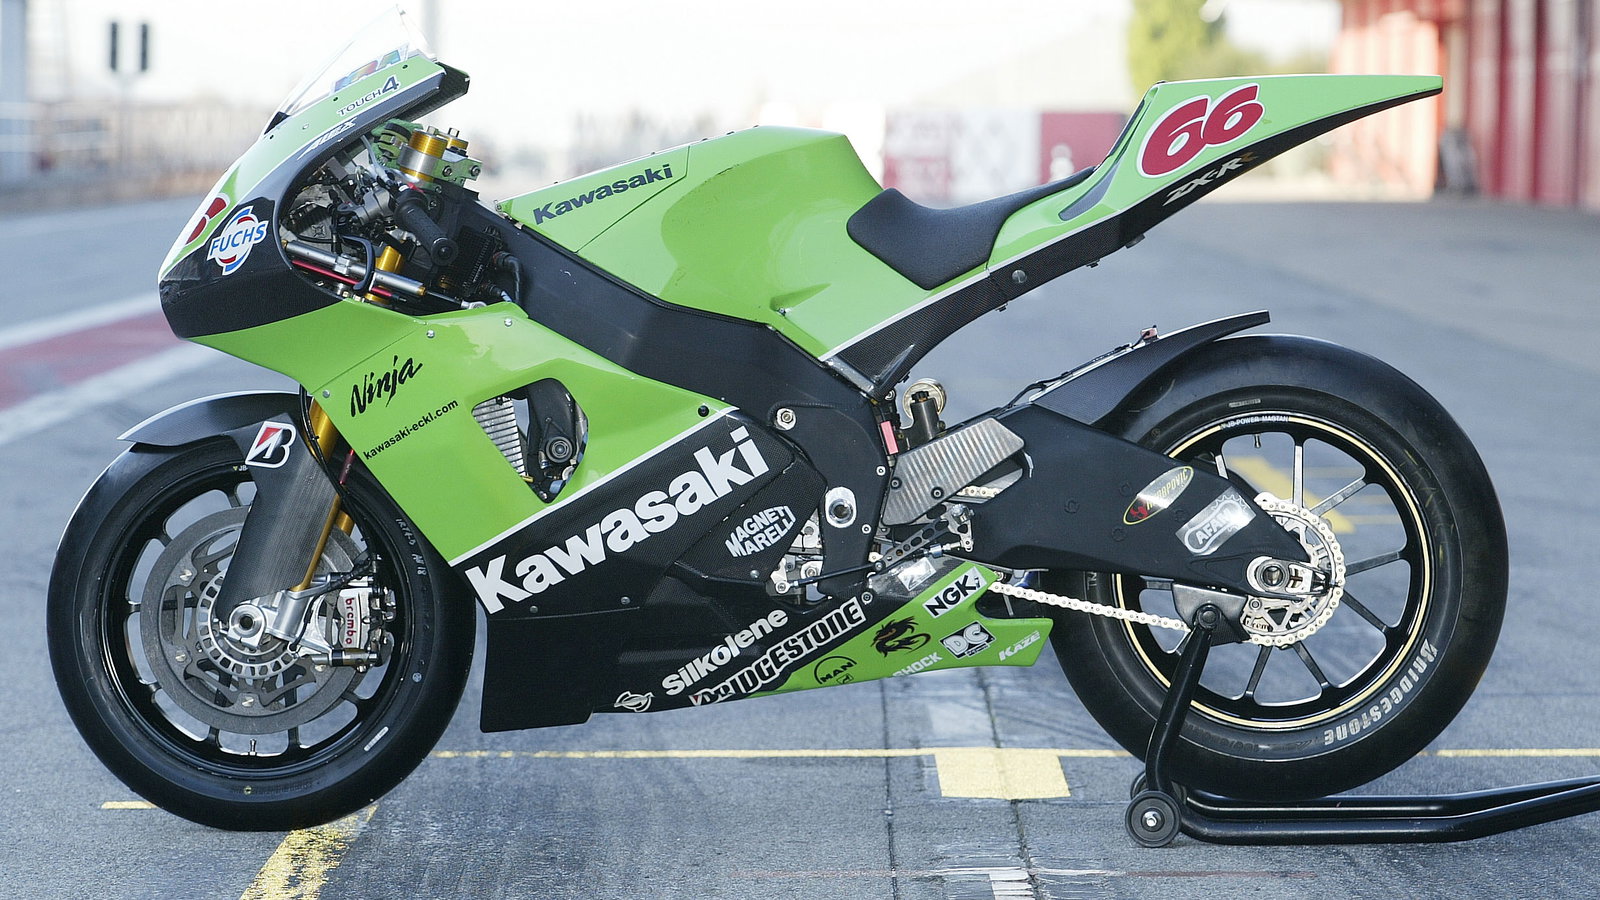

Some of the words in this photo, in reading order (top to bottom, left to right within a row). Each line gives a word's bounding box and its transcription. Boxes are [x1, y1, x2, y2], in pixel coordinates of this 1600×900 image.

[1141, 85, 1263, 176] 66
[532, 164, 673, 225] Kawasaki
[210, 223, 266, 256] FUCHS
[350, 355, 423, 417] Ninja
[363, 400, 459, 461] kawasaki-eckl.com
[465, 425, 770, 615] Kawasaki
[724, 504, 796, 557] MAGNETI
[924, 574, 977, 616] NGK
[689, 596, 867, 706] BRIDGESTONE
[943, 621, 989, 656] DC
[819, 661, 855, 683] MAN
[1324, 638, 1438, 746] BRIDGESTONE
